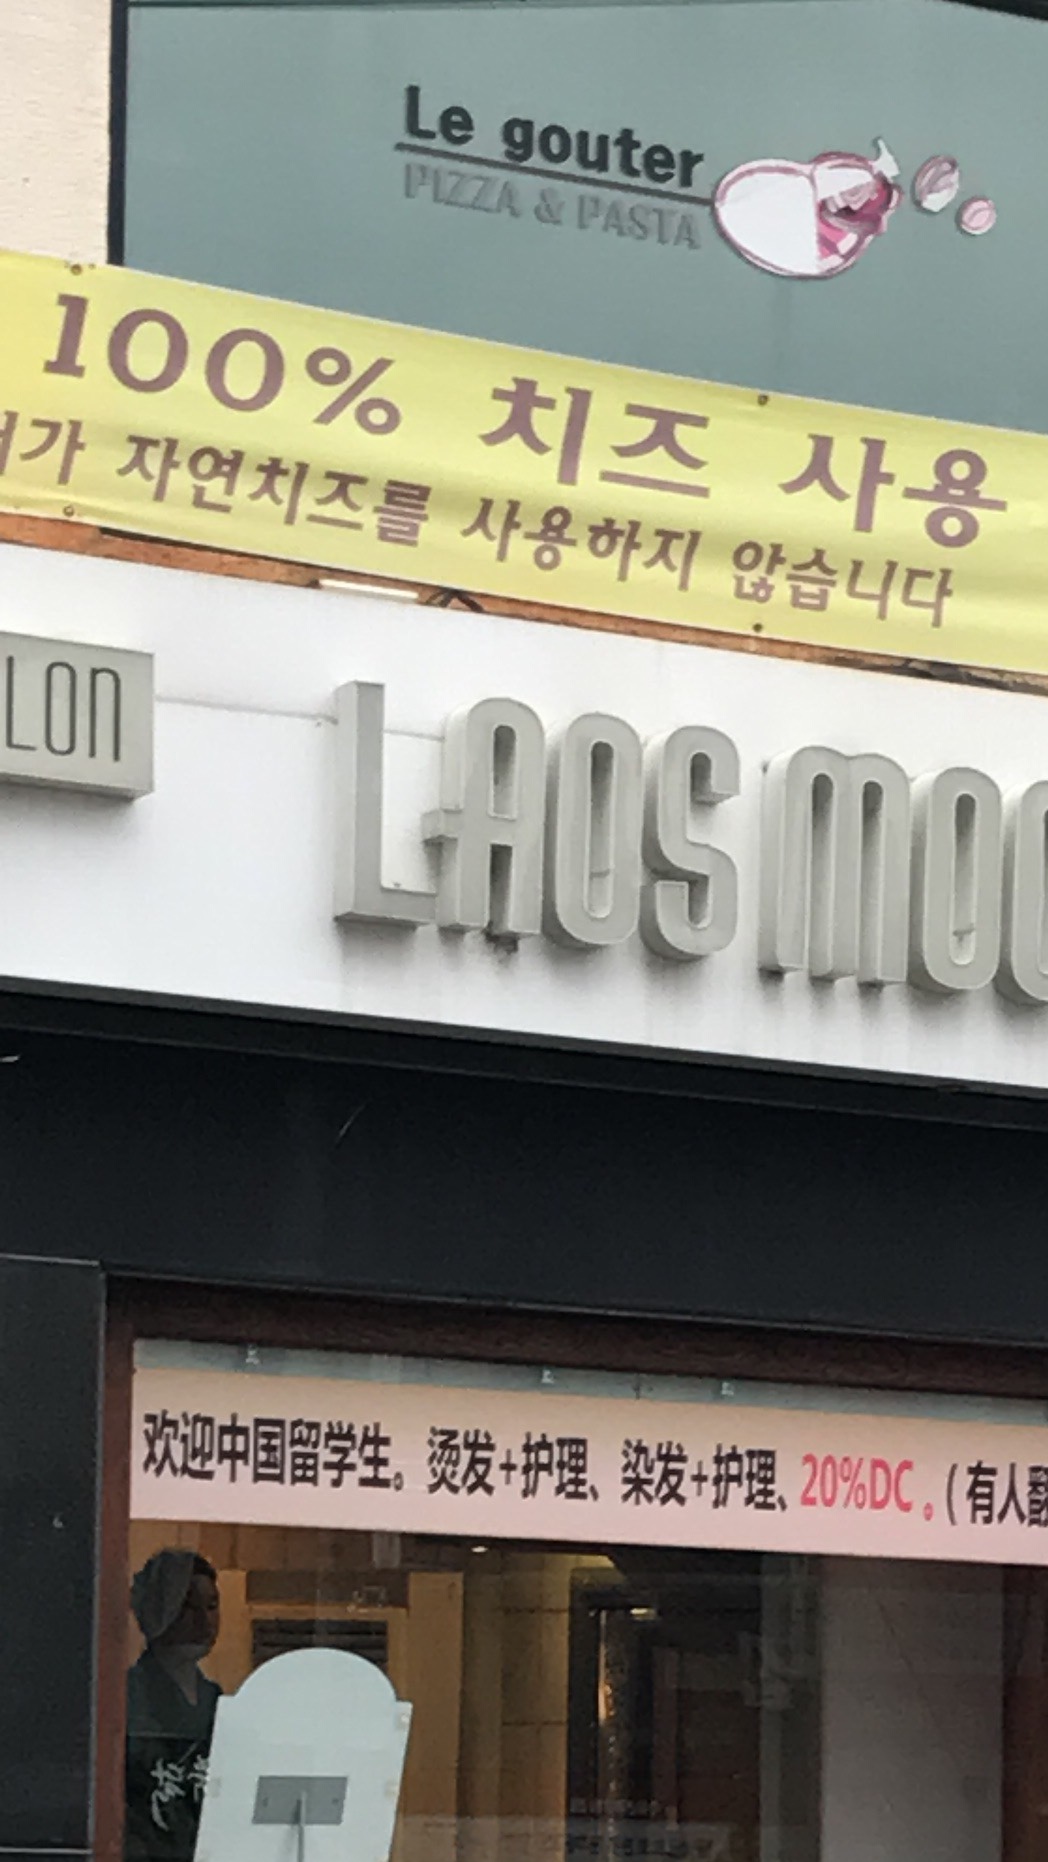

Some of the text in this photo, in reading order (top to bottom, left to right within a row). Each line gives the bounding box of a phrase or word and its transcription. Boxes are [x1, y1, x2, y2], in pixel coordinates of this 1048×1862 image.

[404, 84, 705, 188] Le gouter
[404, 162, 699, 250] PIZZA & PASTA
[42, 292, 1008, 549] 100% 치즈 사용
[117, 434, 432, 547] 자연치즈를
[461, 497, 703, 591] 사용하지
[731, 538, 954, 629] 않습니다
